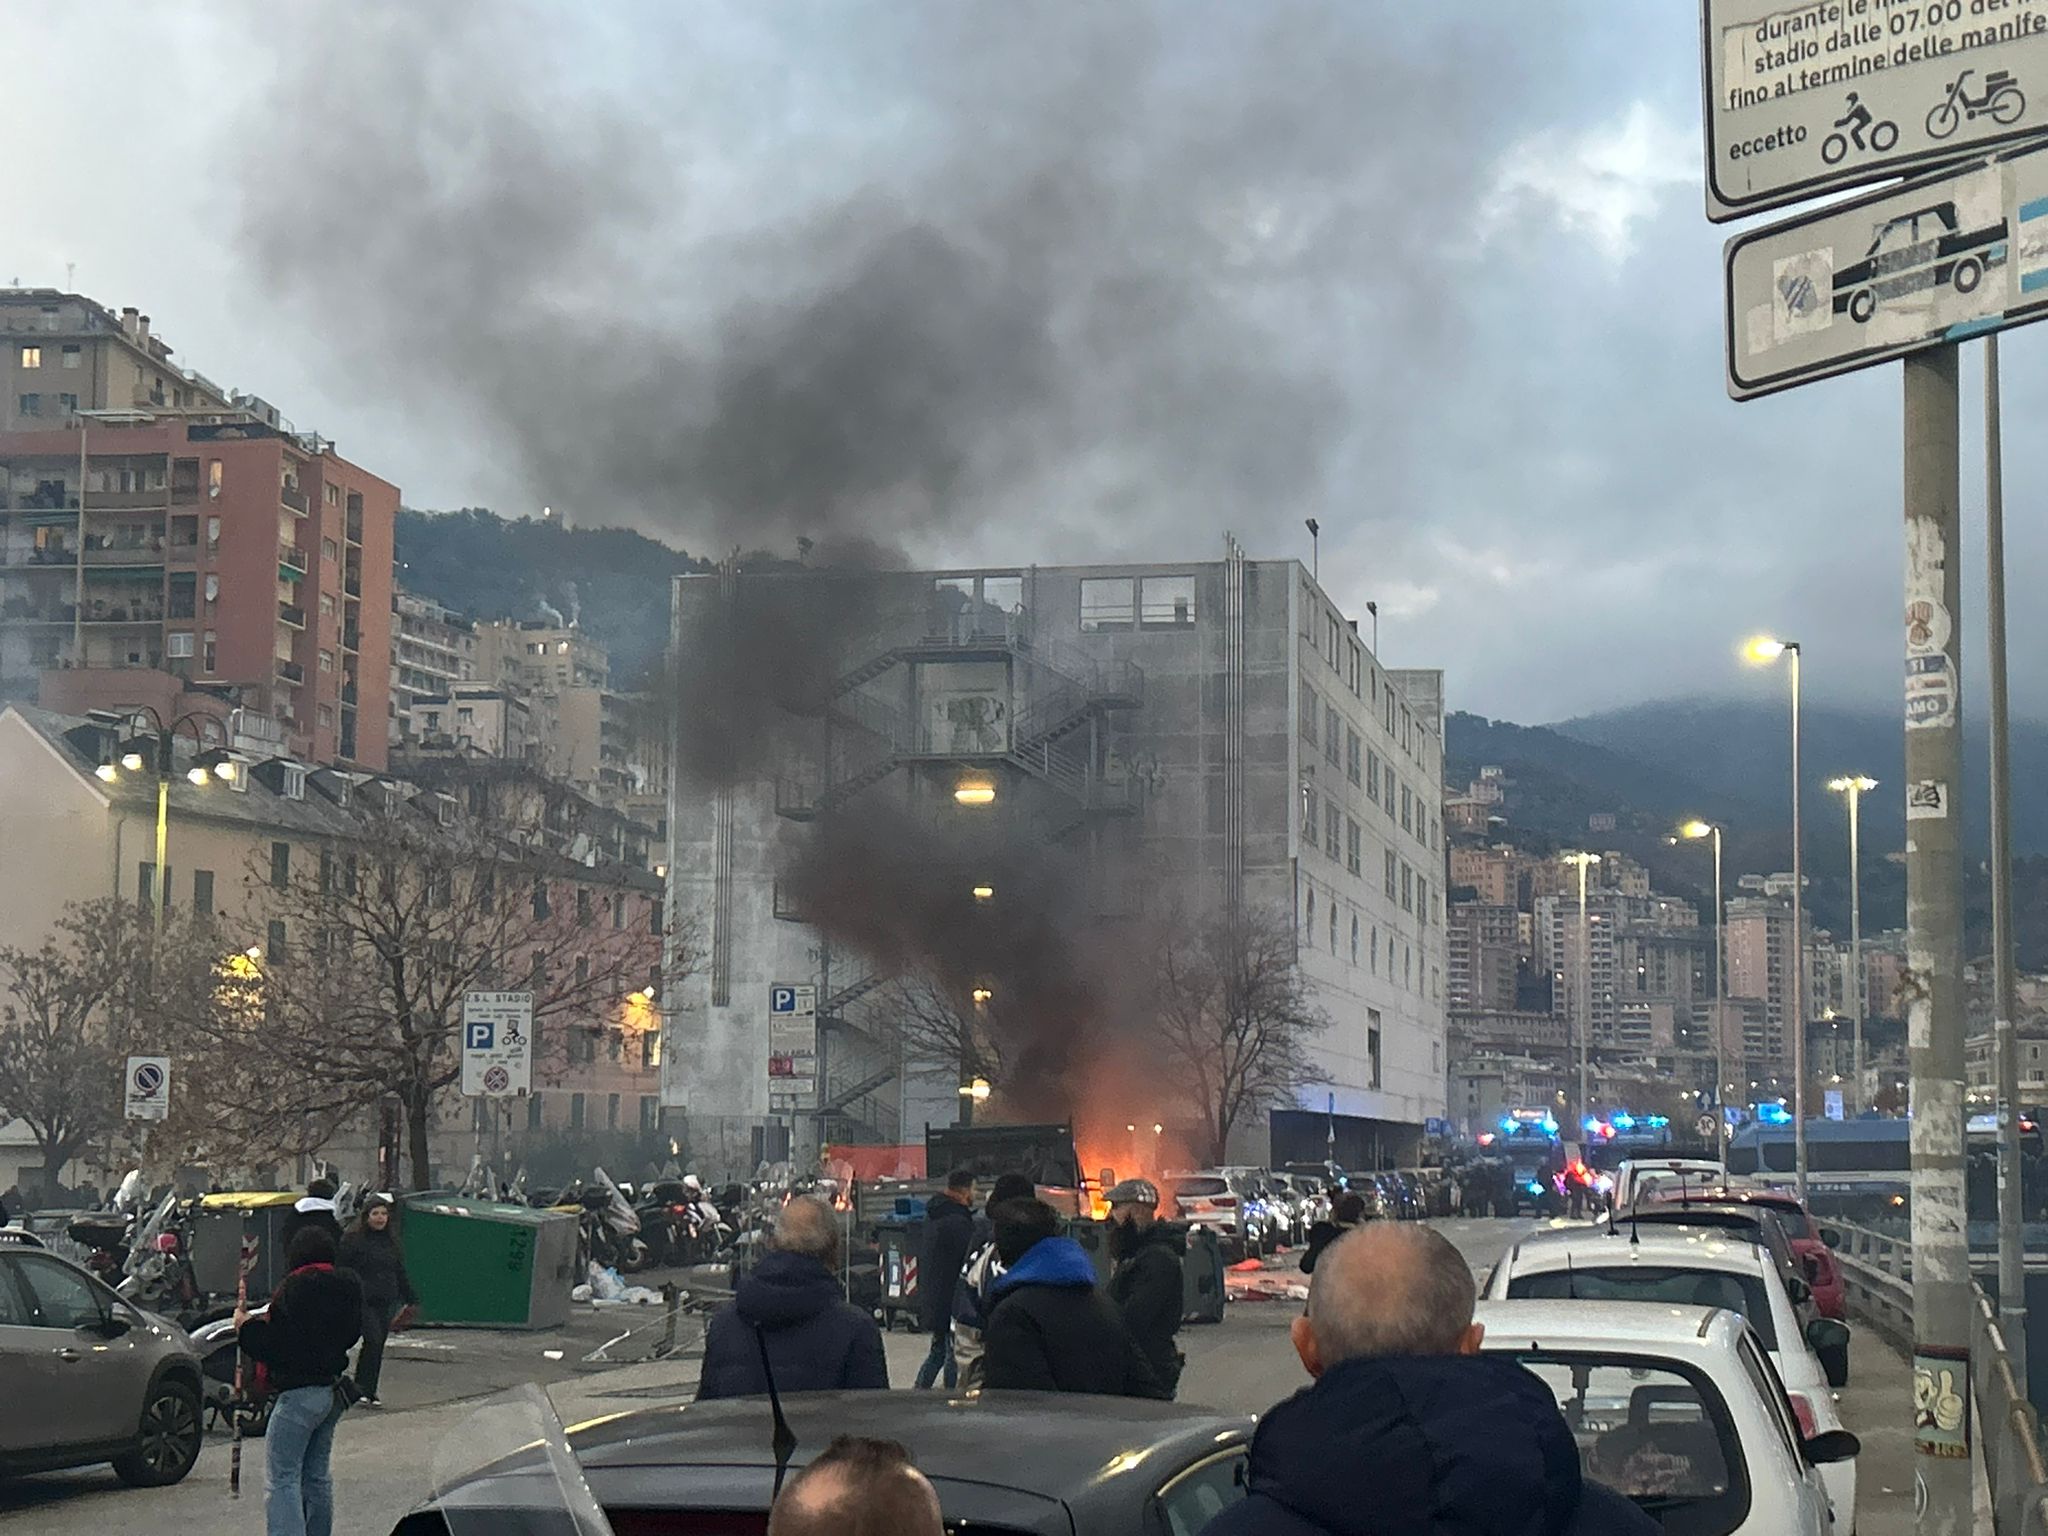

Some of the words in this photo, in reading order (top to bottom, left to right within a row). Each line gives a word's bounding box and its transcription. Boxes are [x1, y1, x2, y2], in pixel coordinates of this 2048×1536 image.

[1755, 4, 1840, 43] durante
[1755, 39, 1819, 74] stadio
[1825, 23, 1882, 52] dalle
[1890, 0, 1962, 35] 07.00
[1729, 86, 1768, 110] fino
[1774, 73, 1796, 98] al
[1800, 53, 1886, 90] termine
[1893, 34, 1953, 66] delle
[1961, 12, 2047, 50] manife
[1729, 125, 1807, 160] eccetto
[495, 994, 531, 1003] STADIO
[776, 990, 791, 1010] P
[472, 1025, 490, 1047] P
